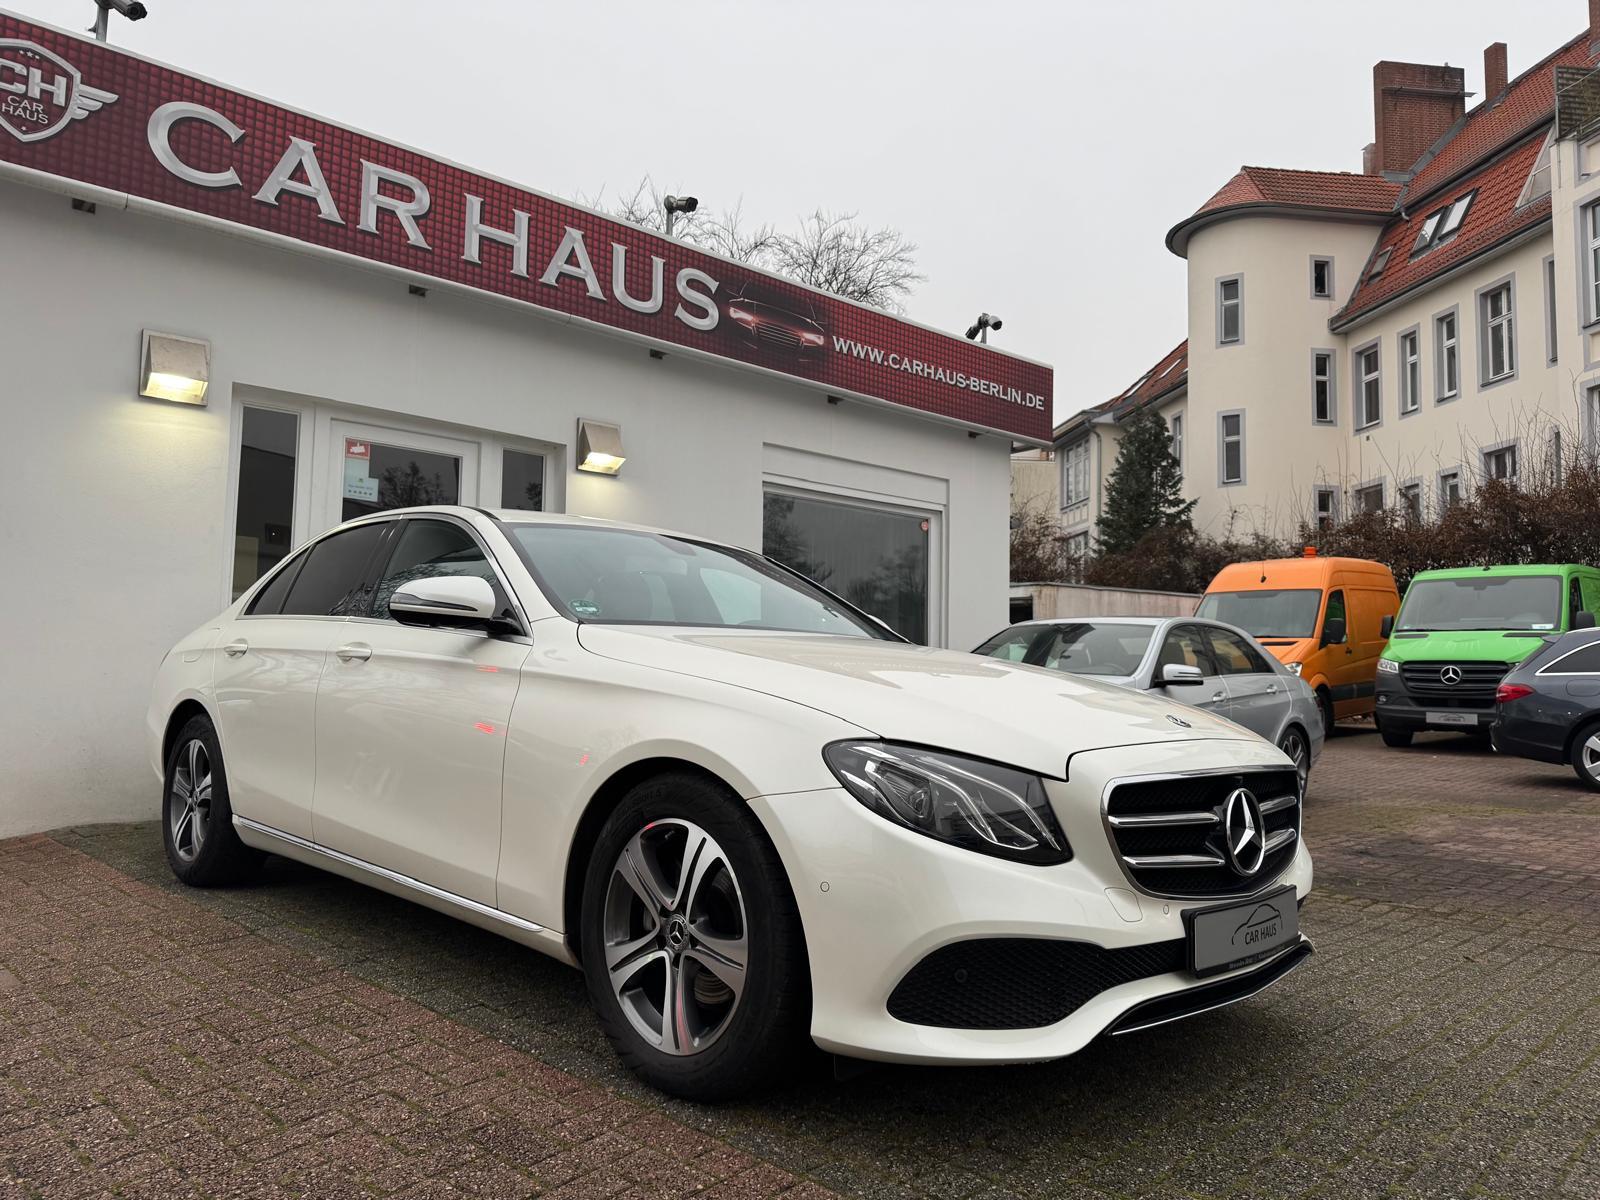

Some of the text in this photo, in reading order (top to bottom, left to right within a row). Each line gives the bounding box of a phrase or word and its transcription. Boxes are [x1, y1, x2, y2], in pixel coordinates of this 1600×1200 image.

[1, 103, 49, 124] HAUS
[7, 95, 44, 113] CAR
[147, 101, 720, 331] CAR HAUS
[832, 335, 1045, 411] WWW.CARHAUS-BERLIN.DE
[1244, 922, 1277, 945] CAR HAUS
